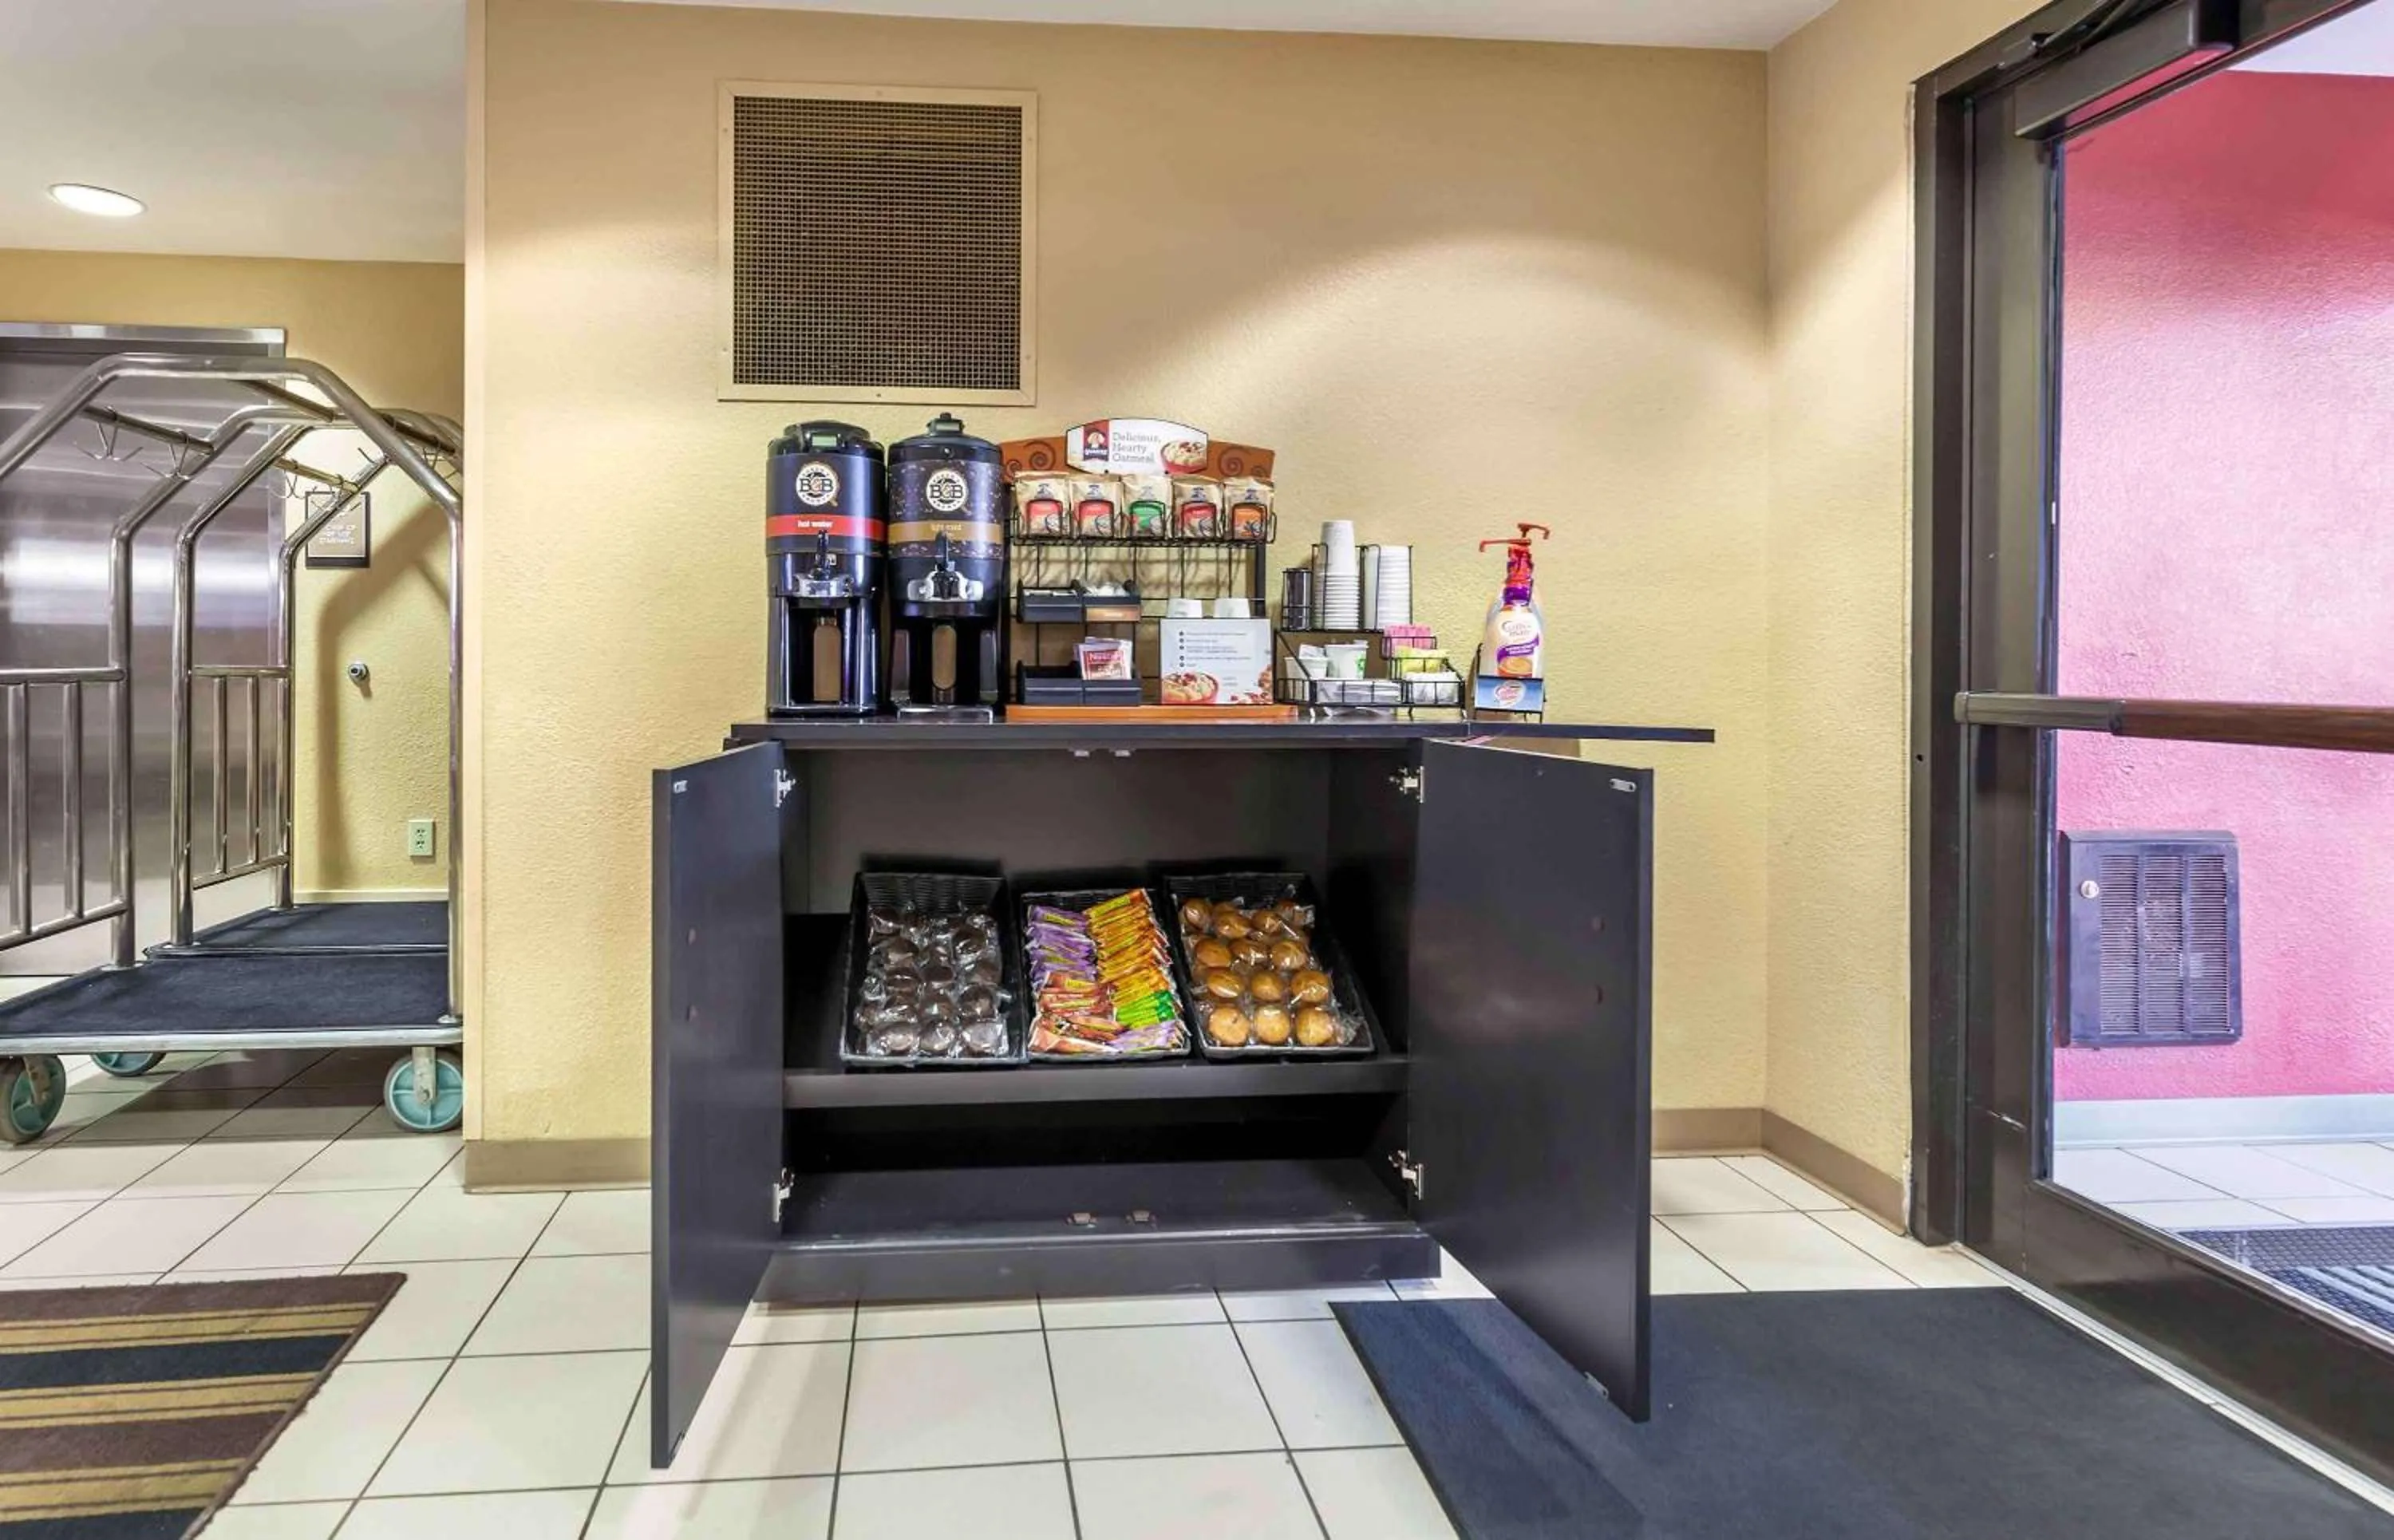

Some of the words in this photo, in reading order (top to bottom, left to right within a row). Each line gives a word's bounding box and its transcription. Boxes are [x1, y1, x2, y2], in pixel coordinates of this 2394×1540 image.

[1112, 432, 1161, 443] Delicious,
[1112, 442, 1147, 453] Hearty
[1112, 452, 1155, 463] Oatmeal
